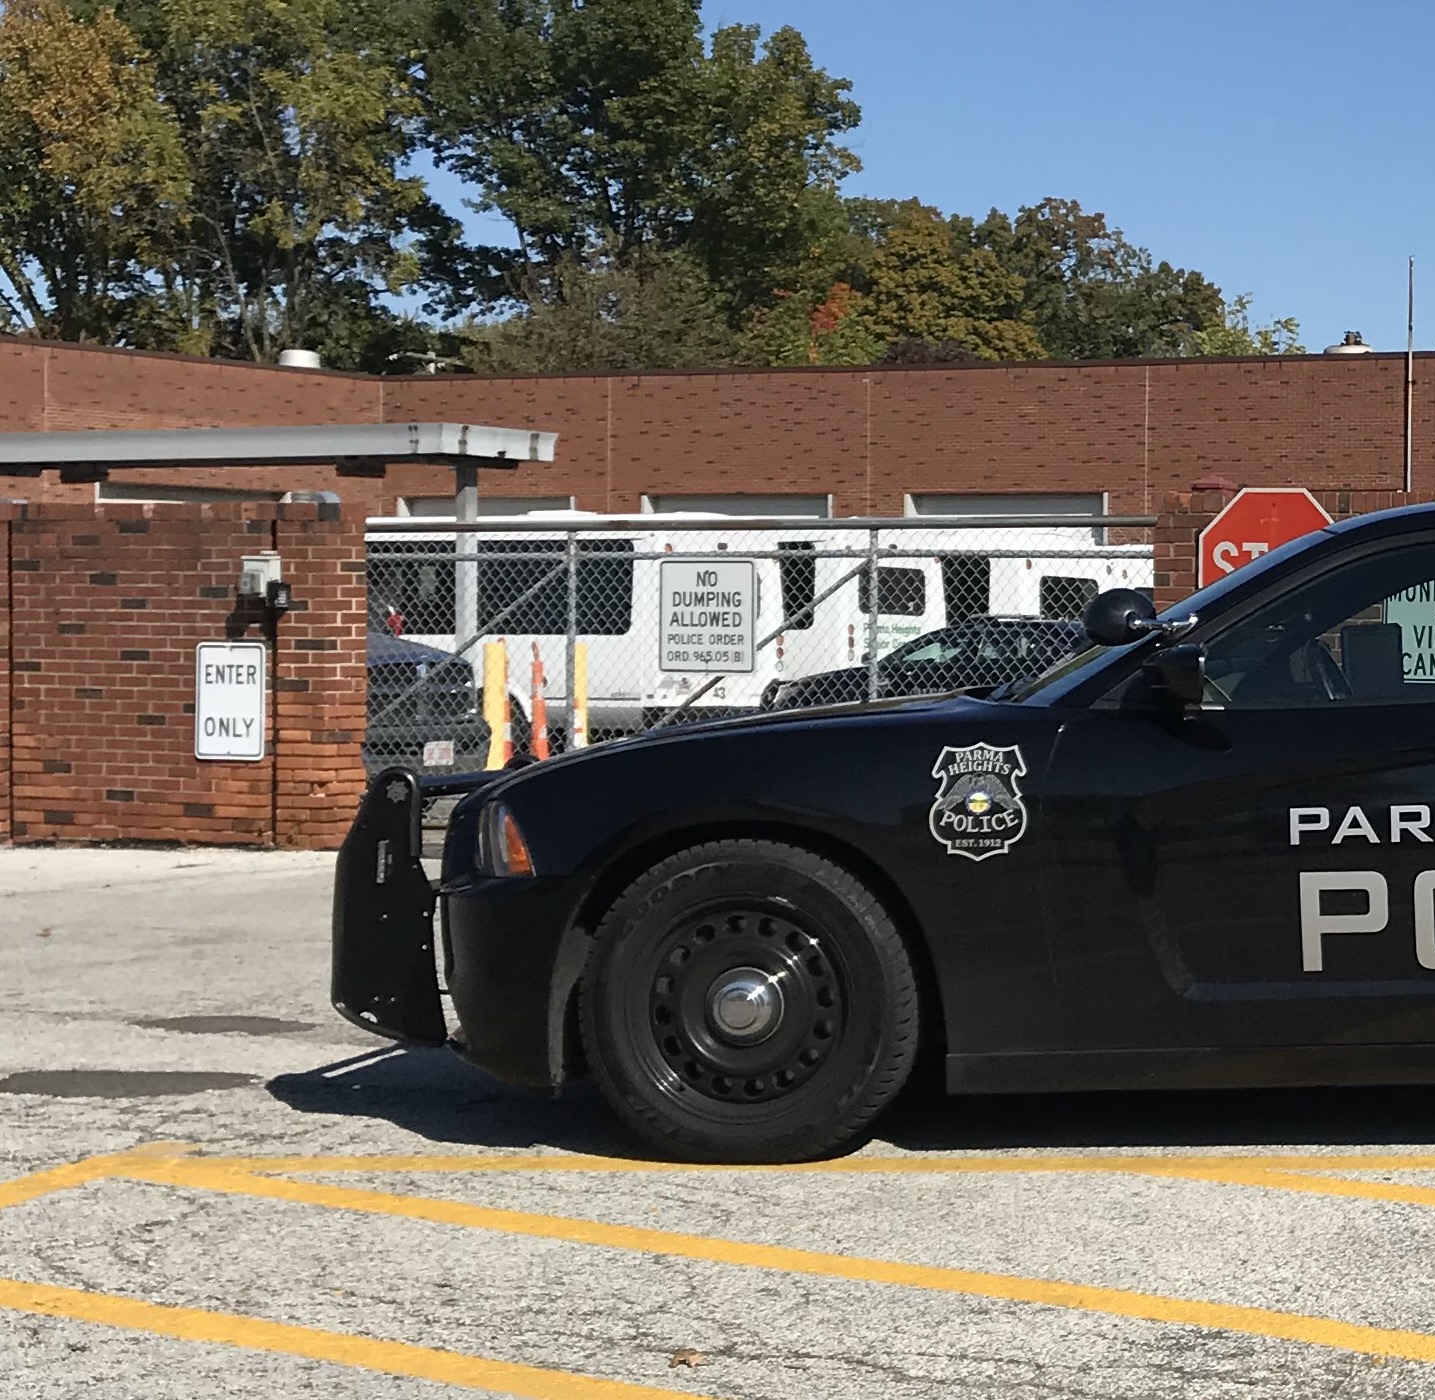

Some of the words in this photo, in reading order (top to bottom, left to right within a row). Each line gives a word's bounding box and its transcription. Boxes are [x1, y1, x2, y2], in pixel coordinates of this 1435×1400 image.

[696, 571, 718, 587] NO
[672, 591, 742, 608] DUMPING
[669, 611, 743, 627] ALLOWED
[667, 633, 704, 645] POLICE
[709, 634, 745, 646] ORDER
[667, 651, 691, 662] ORD.
[205, 664, 257, 685] ENTER
[204, 717, 255, 737] ONLY
[955, 749, 1004, 763] PARMA
[948, 760, 1011, 776] HEIGHTS
[939, 808, 1019, 833] POLICE
[955, 839, 978, 847] EST.
[979, 838, 1002, 847] 1912
